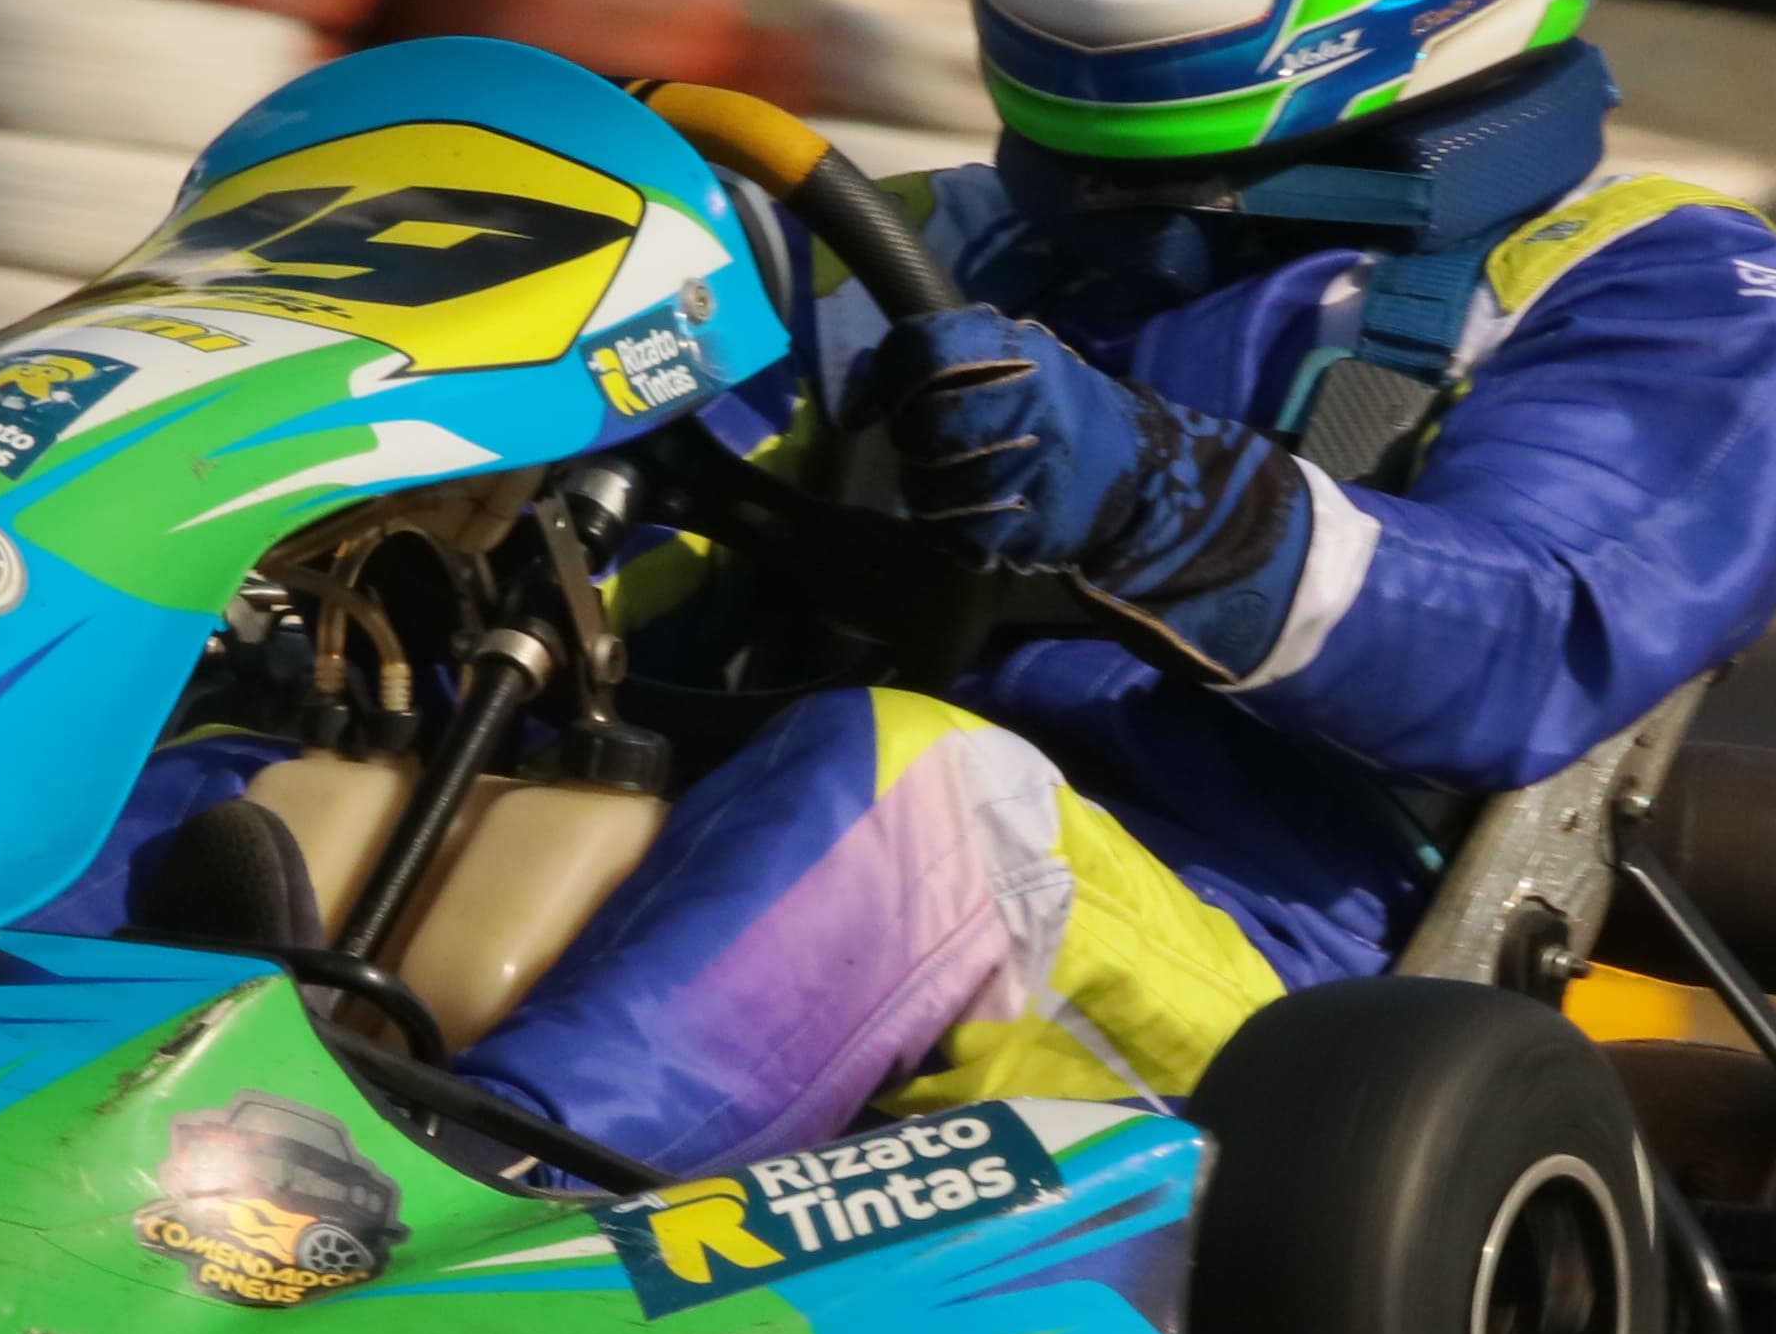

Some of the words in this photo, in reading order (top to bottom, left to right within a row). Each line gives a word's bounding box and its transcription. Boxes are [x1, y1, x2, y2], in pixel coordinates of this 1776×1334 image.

[614, 328, 680, 376] Rizato
[629, 363, 699, 408] Tintas
[746, 1115, 992, 1199] Rizato
[767, 1154, 1019, 1253] Tintas
[199, 1261, 307, 1304] PNEUS
